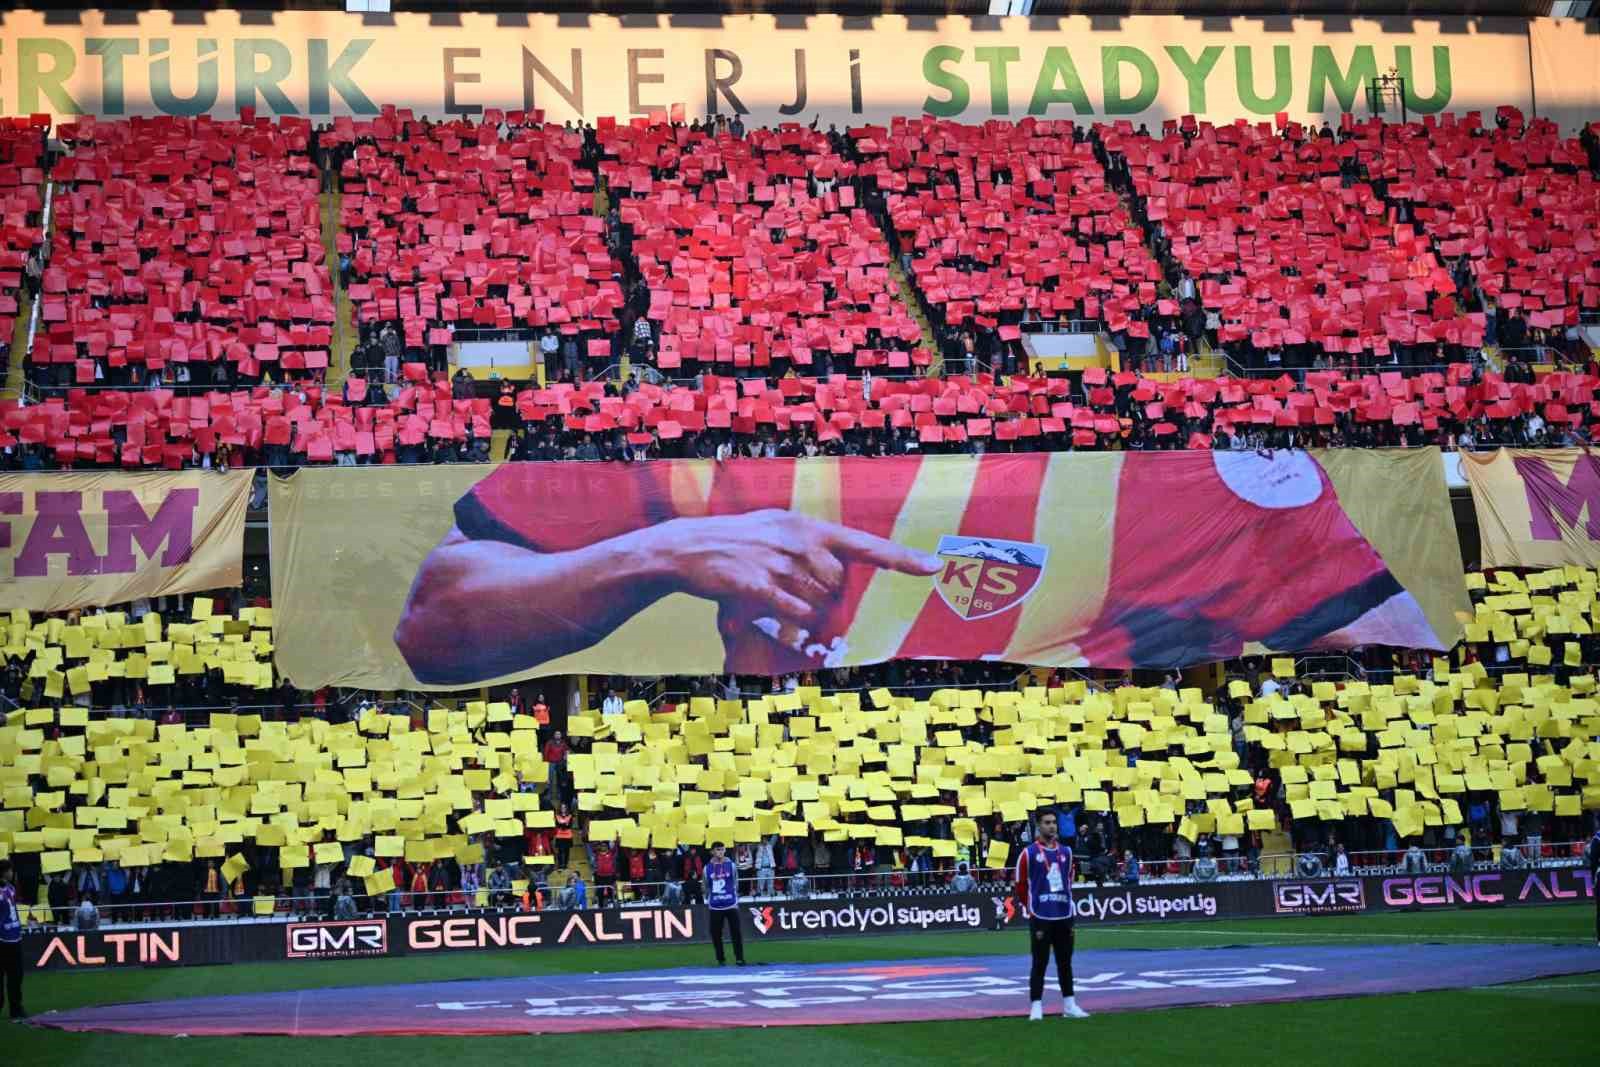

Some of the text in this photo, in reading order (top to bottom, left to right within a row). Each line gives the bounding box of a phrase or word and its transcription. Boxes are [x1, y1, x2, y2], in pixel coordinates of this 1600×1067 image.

[0, 37, 379, 116] RTÜRK
[921, 44, 1453, 117] STADYUMU
[942, 560, 1018, 595] KS
[955, 595, 992, 611] 1966
[1280, 883, 1361, 906] GMR
[557, 909, 693, 943] ALTIN
[778, 902, 895, 931] trendyol
[37, 931, 180, 967] ALTIN
[292, 926, 383, 951] GMR
